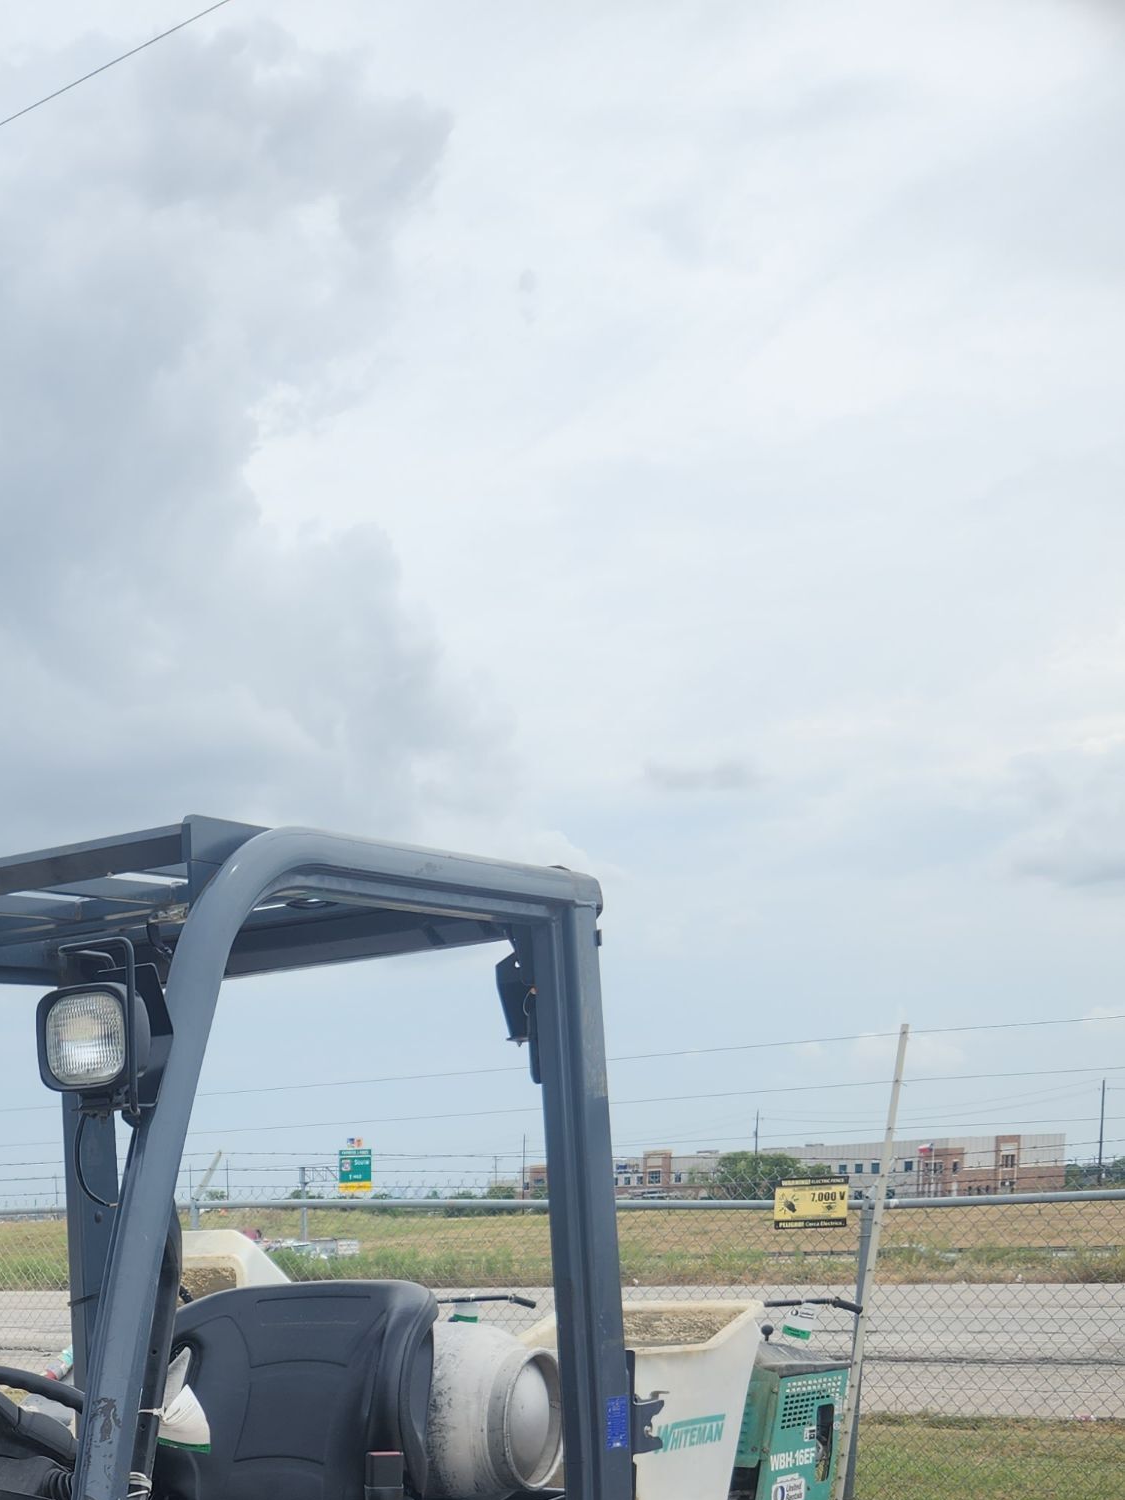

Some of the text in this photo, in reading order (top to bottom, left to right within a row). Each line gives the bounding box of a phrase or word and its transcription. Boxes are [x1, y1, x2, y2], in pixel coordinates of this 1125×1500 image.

[839, 1190, 846, 1201] V
[654, 1421, 725, 1455] WHITEMAN
[770, 1447, 815, 1472] WBH-16EF
